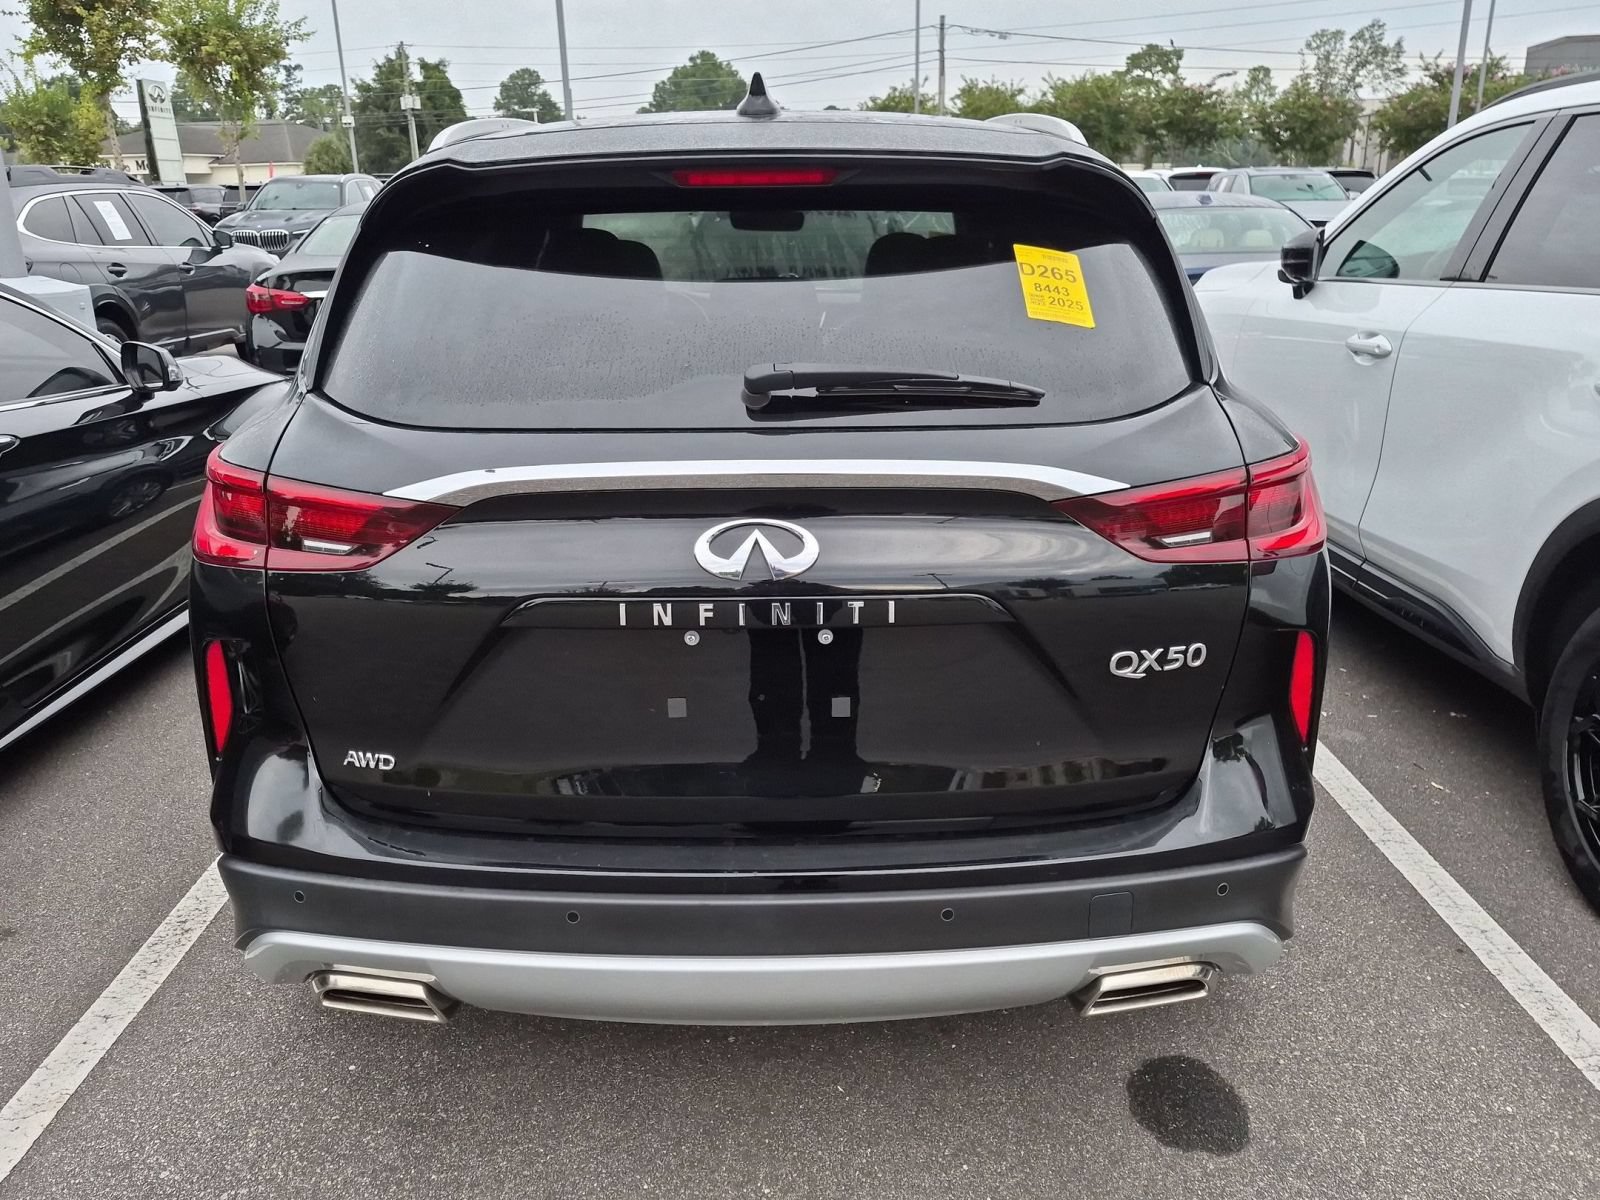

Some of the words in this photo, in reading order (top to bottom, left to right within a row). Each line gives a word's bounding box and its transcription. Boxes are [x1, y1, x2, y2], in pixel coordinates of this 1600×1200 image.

[1020, 262, 1077, 283] D265
[1034, 282, 1070, 297] 8443
[1048, 296, 1084, 311] 2025
[619, 600, 895, 626] INFINITI
[1109, 642, 1207, 679] QX50
[343, 750, 396, 771] AWD
